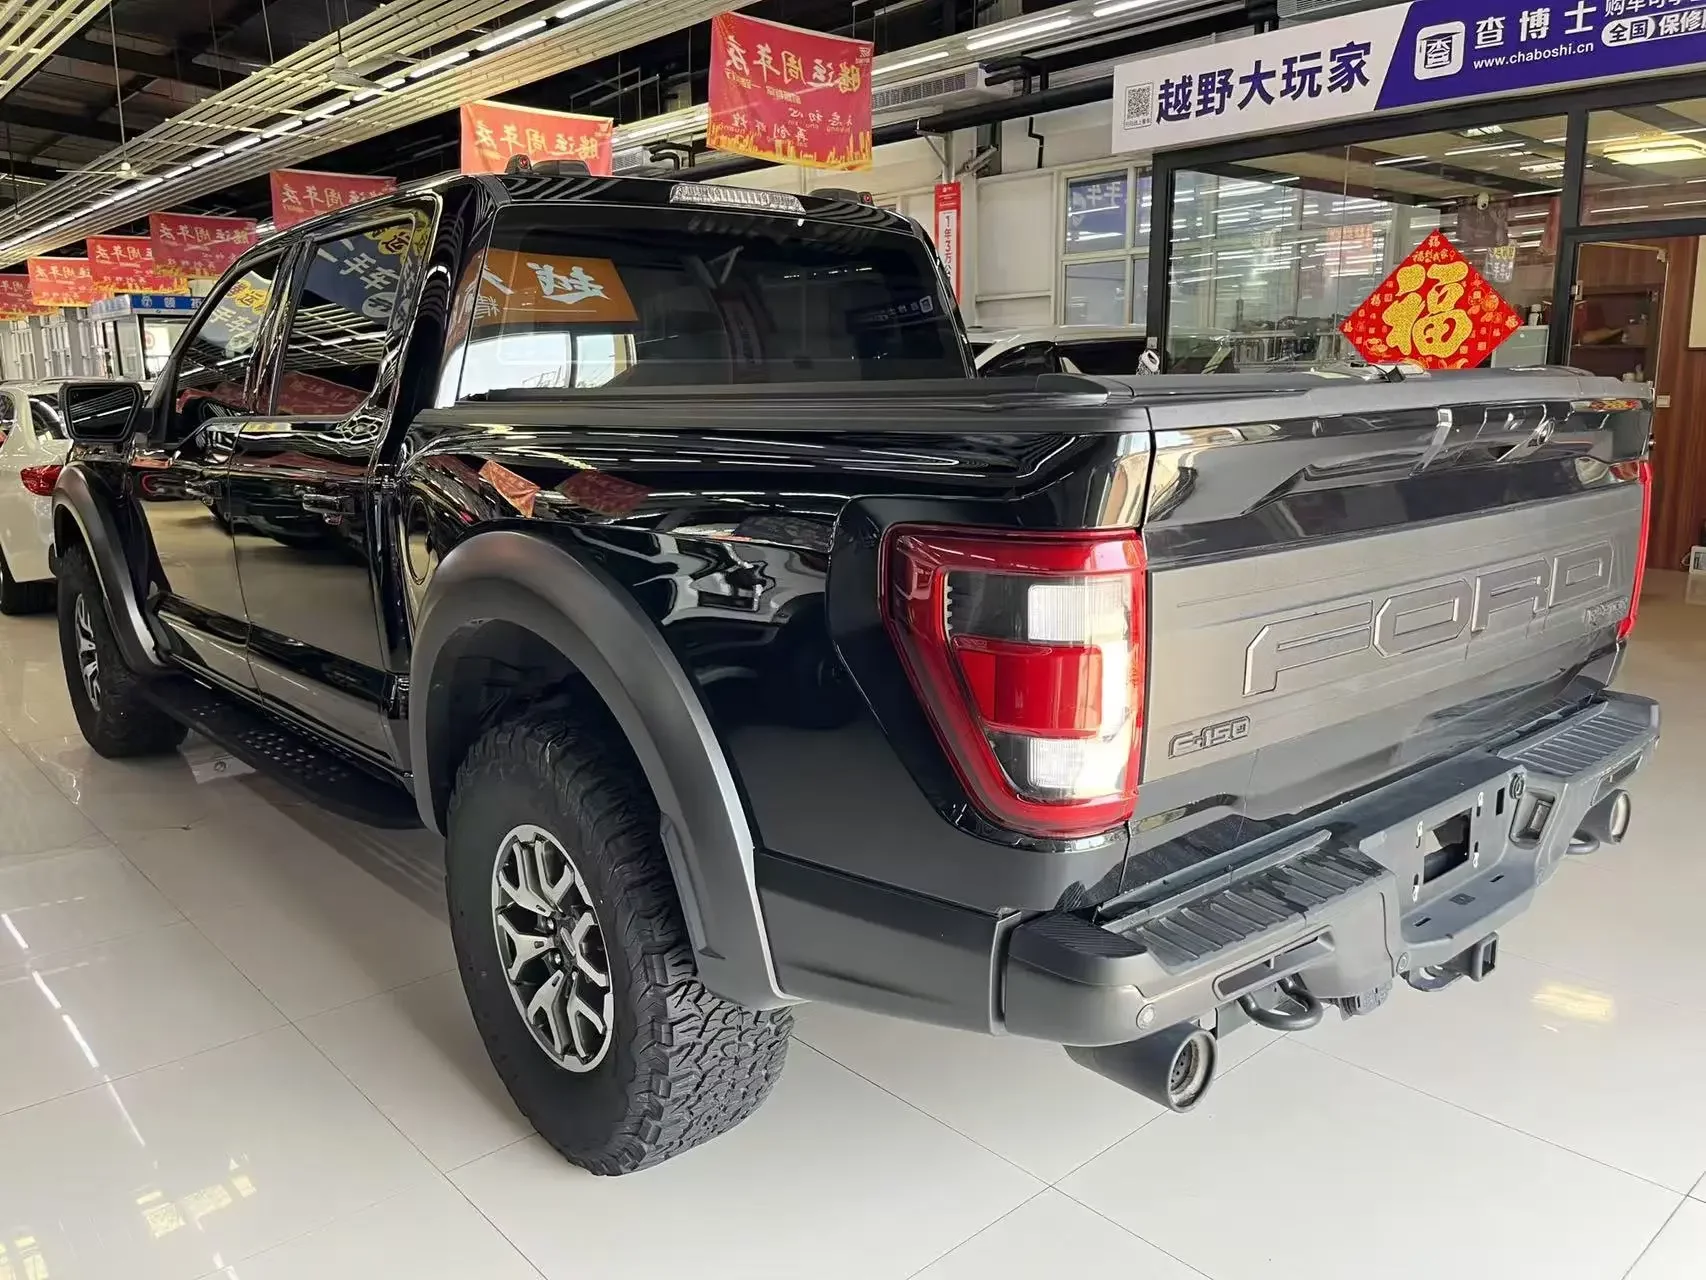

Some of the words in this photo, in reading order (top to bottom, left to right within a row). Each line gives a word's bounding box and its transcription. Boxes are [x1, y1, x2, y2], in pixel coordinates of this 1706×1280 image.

[1473, 41, 1594, 69] www.chaboshi.cn
[1474, 1, 1596, 49] 查博士
[1156, 41, 1372, 124] 越野大玩家
[1382, 261, 1473, 358] 福
[1243, 540, 1614, 696] FORD
[1168, 715, 1251, 760] F-150
